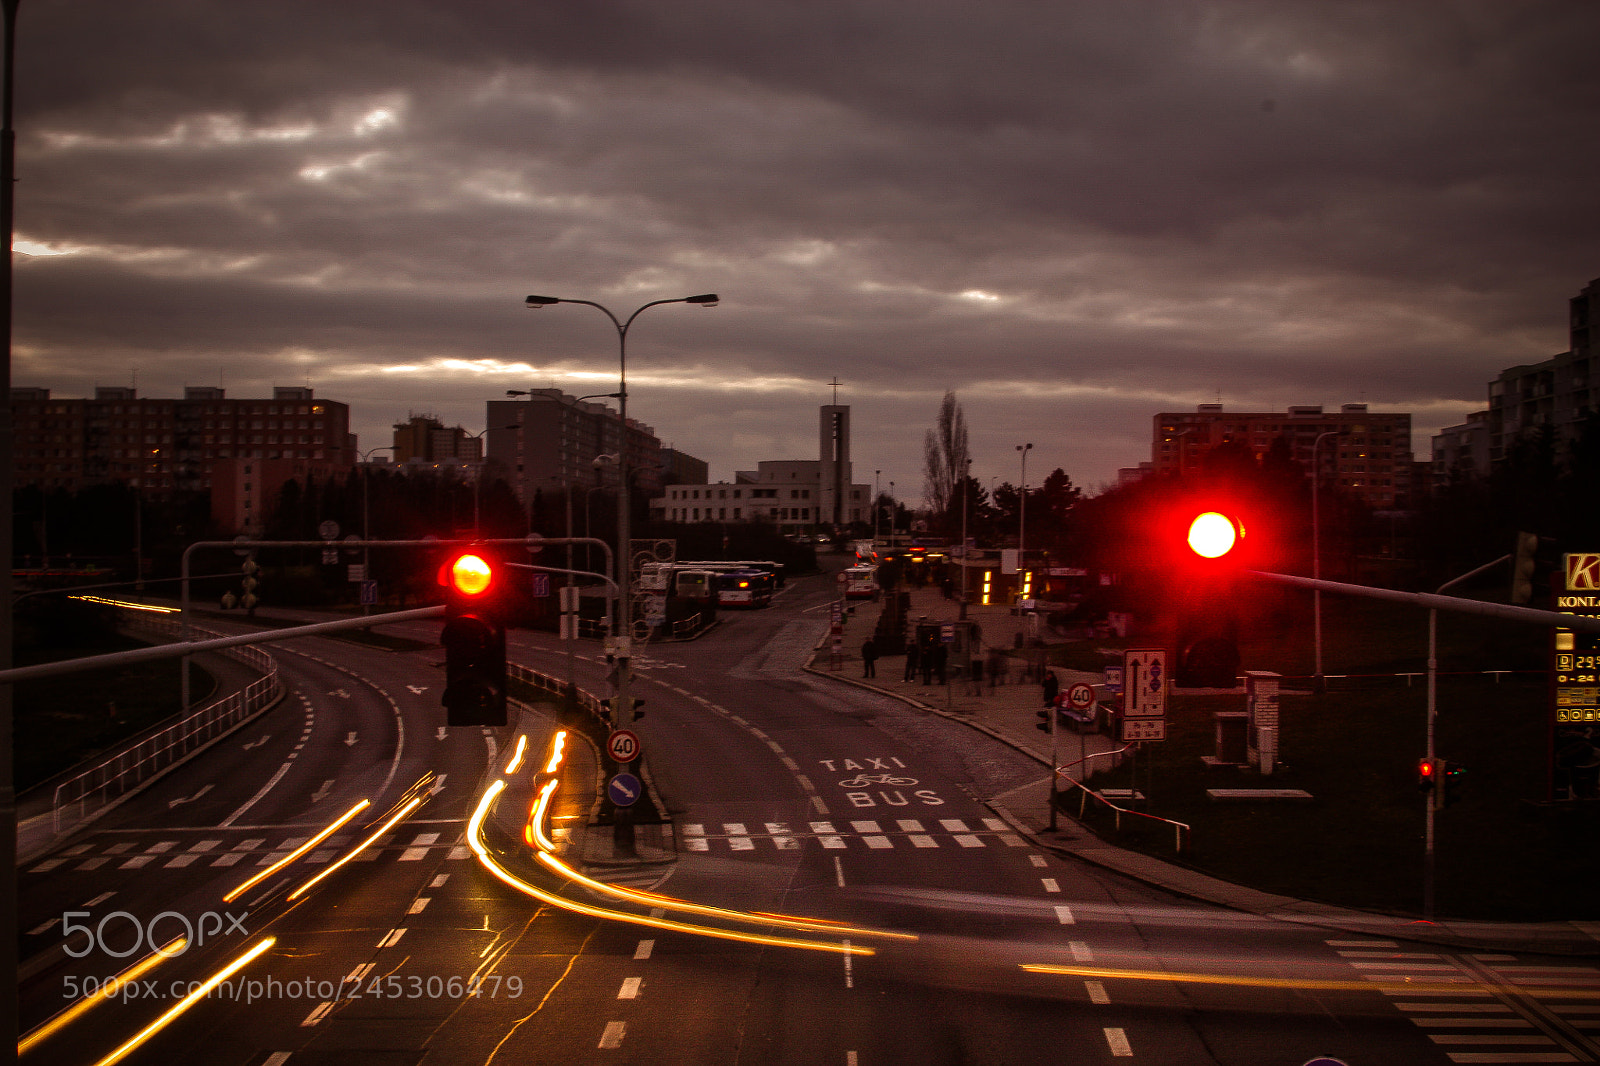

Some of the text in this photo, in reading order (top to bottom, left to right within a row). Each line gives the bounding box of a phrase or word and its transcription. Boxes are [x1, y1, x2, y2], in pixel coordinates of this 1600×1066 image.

[1558, 596, 1600, 608] KONT
[1073, 689, 1090, 702] 40
[613, 738, 632, 754] 40
[819, 757, 906, 771] TAXI
[846, 790, 945, 807] BUS
